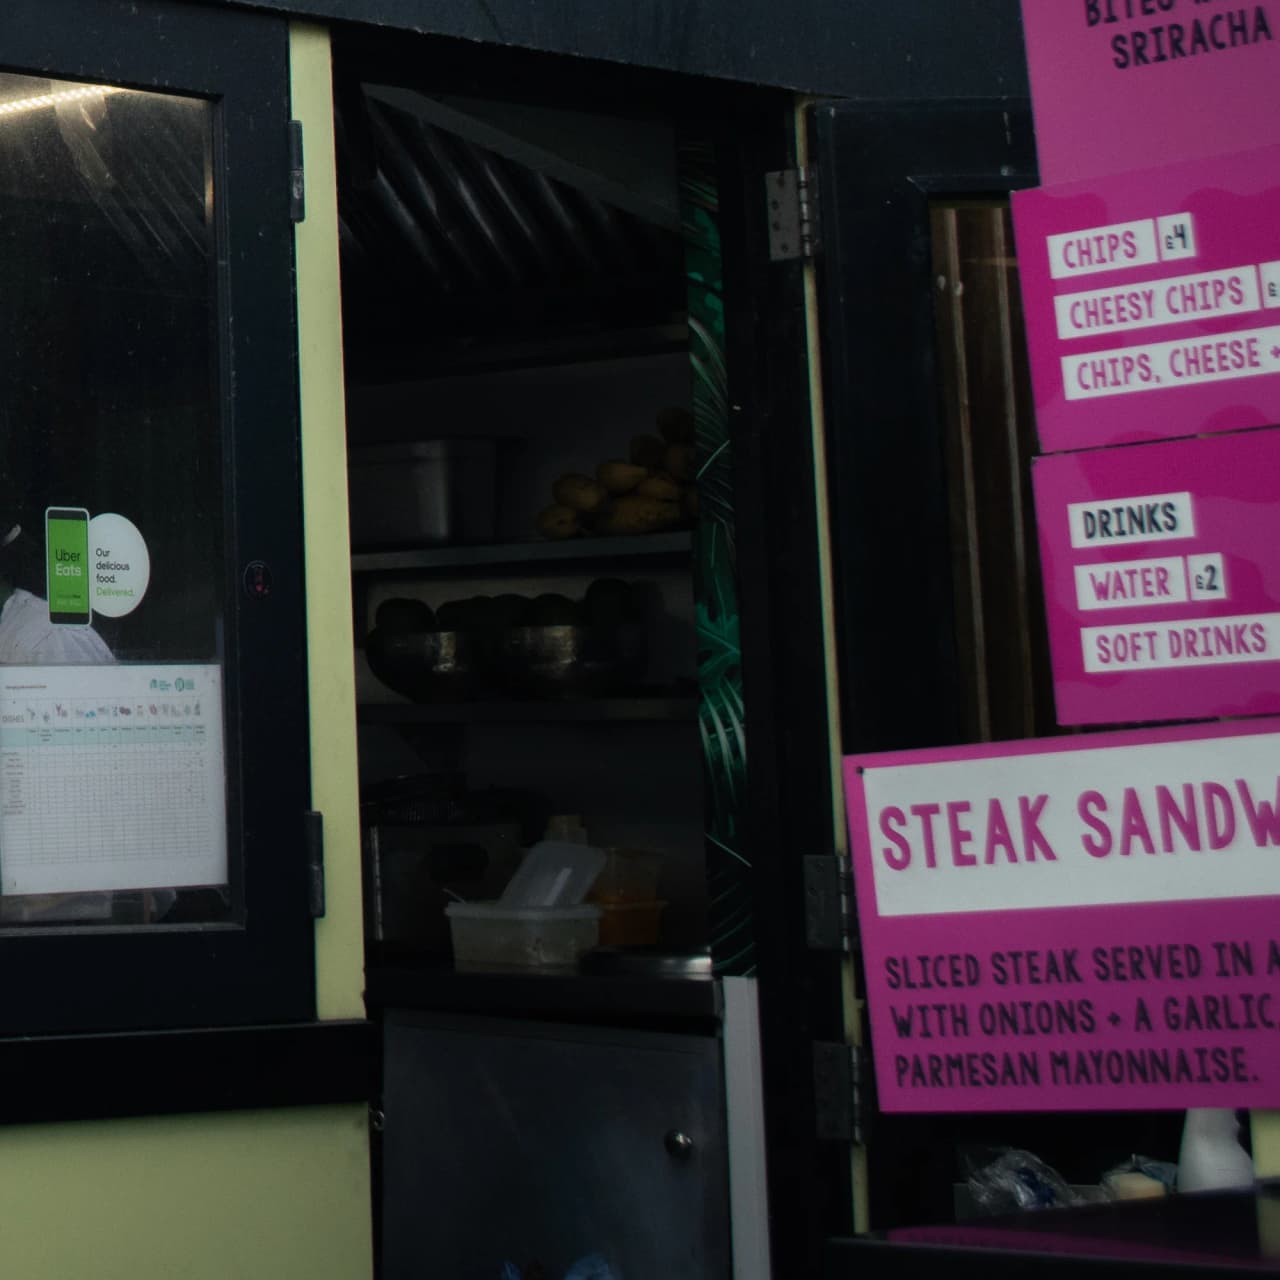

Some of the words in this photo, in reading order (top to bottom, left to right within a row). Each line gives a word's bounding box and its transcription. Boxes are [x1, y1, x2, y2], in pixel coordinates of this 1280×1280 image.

[1111, 6, 1272, 70] SRIRACHA
[1063, 230, 1138, 270] CHIPS
[1165, 223, 1188, 250] £4
[1070, 290, 1156, 330] CHEESY
[1165, 275, 1244, 316] CHIPS
[1076, 351, 1162, 390] CHIPS,
[1169, 337, 1261, 378] CHEESE
[1083, 501, 1178, 540] DRINKS
[55, 549, 80, 561] Uber
[56, 564, 81, 576] Eats
[96, 548, 110, 557] Our
[96, 562, 130, 571] delicious
[96, 574, 117, 583] food.
[1089, 566, 1169, 602] WATER
[1195, 564, 1218, 592] £2
[1096, 630, 1158, 665] SOFT
[1168, 621, 1267, 660] DRINKS
[878, 792, 1057, 871] STEAK
[885, 953, 980, 991] SLICED
[991, 948, 1084, 986] STEAK
[1092, 942, 1202, 983] SERVED
[1214, 939, 1253, 977] IN
[890, 1003, 970, 1041] WITH
[981, 998, 1097, 1035] ONIONS
[1134, 996, 1154, 1033] A
[895, 1051, 1040, 1089] PARMESAN
[1051, 1046, 1261, 1086] MAYONNAISE.
